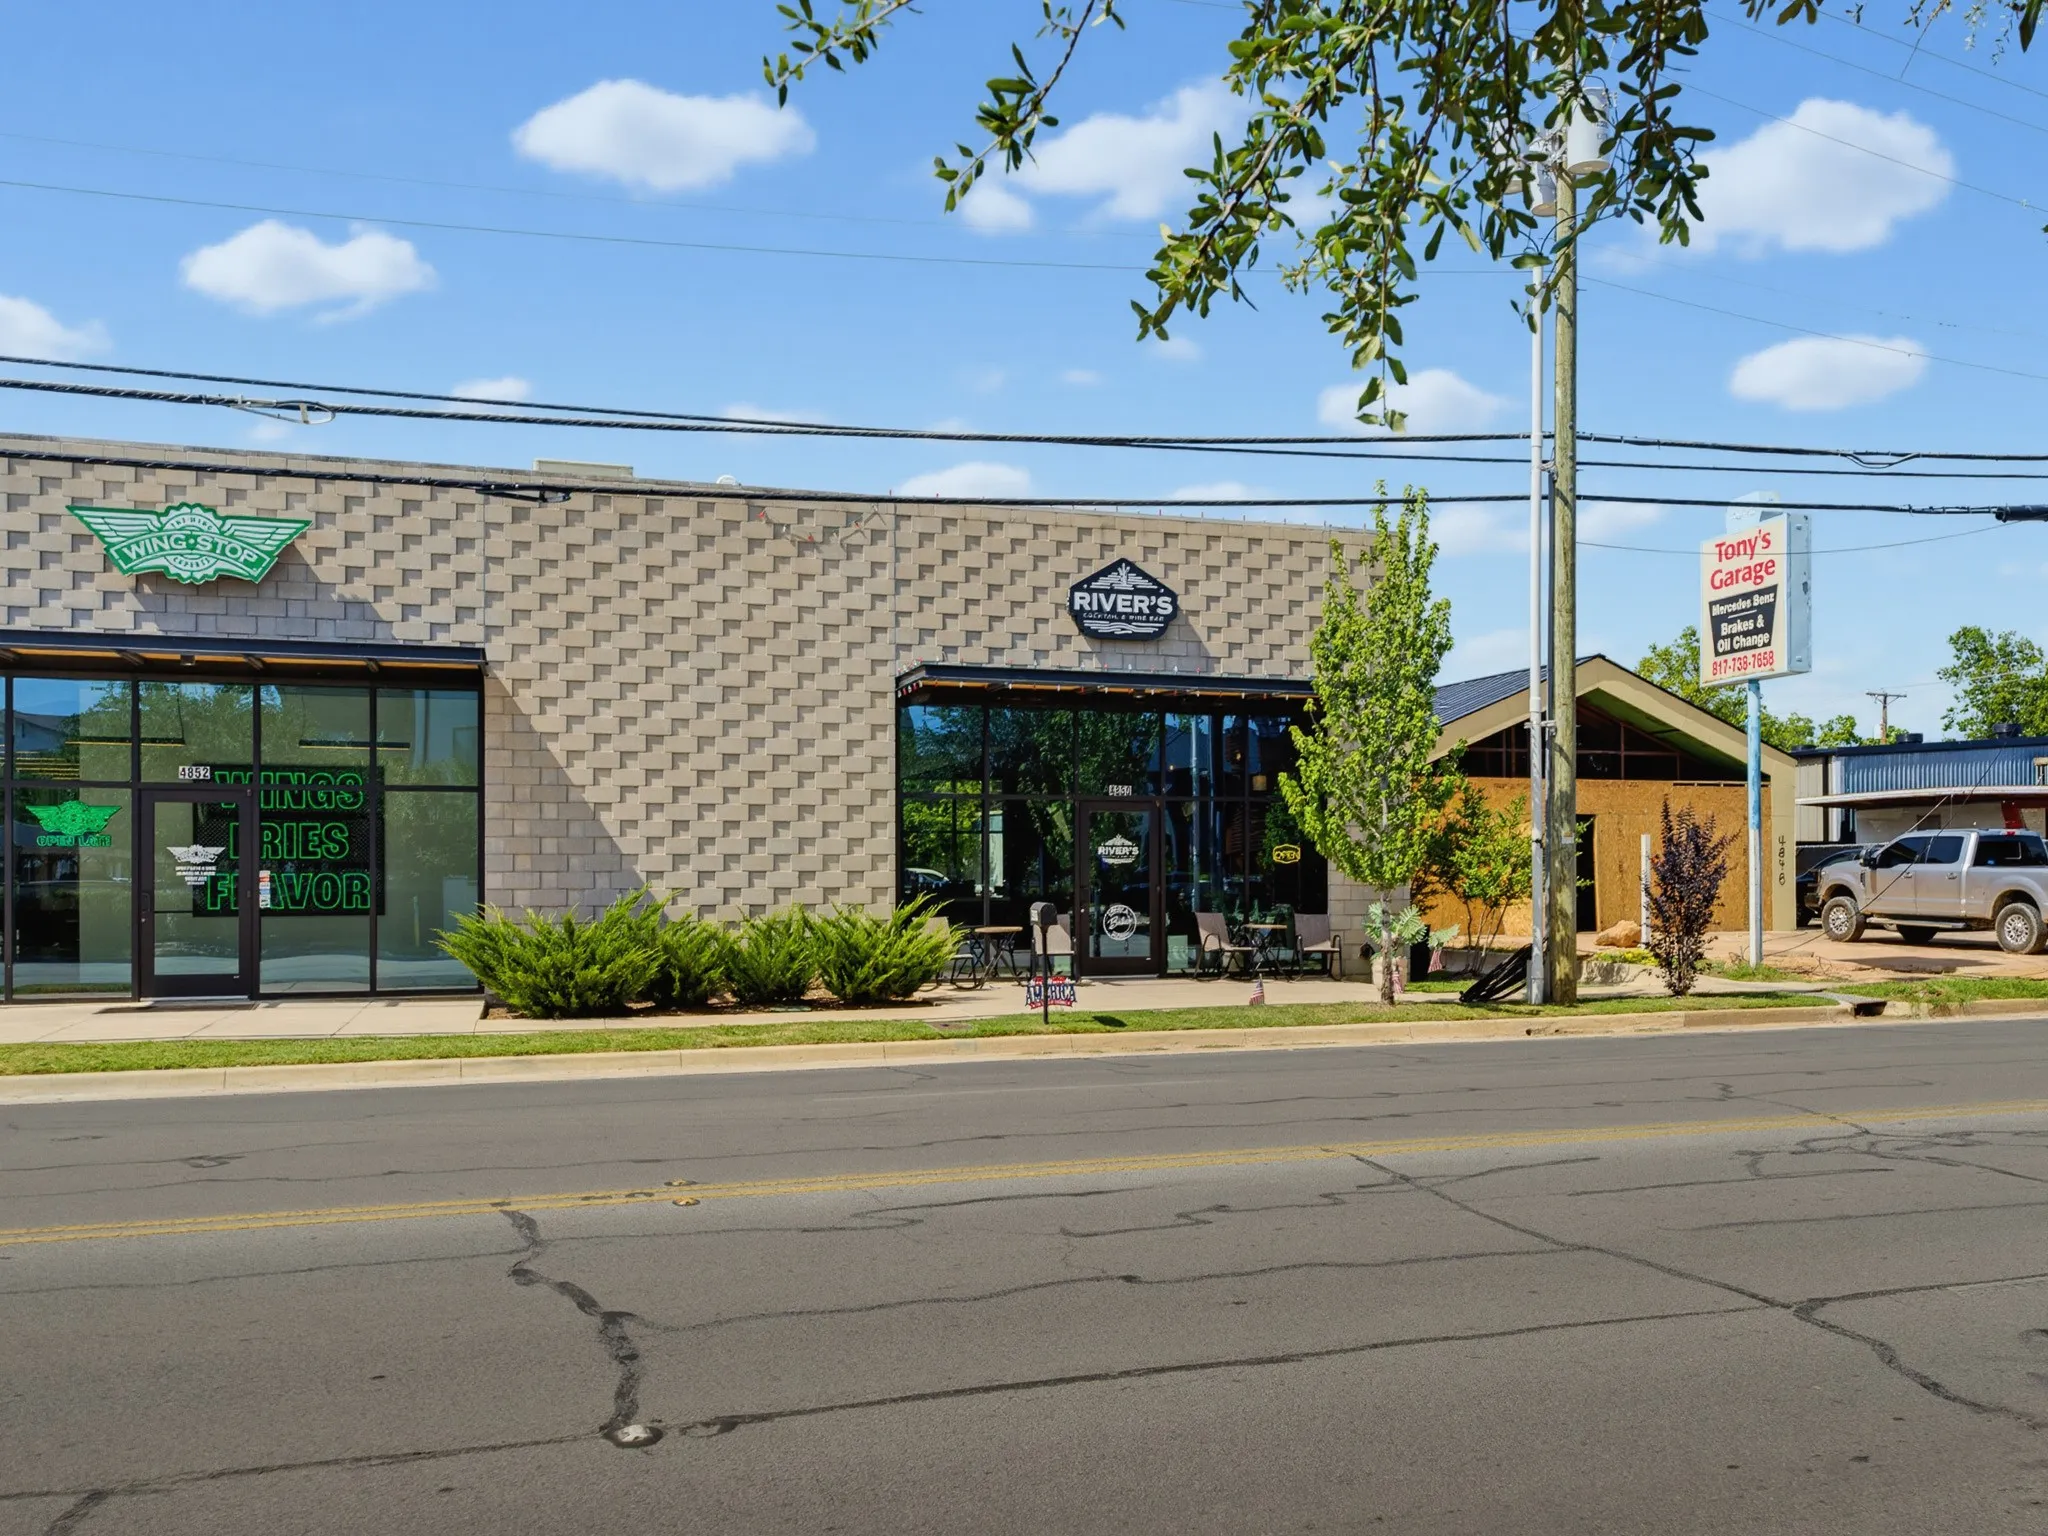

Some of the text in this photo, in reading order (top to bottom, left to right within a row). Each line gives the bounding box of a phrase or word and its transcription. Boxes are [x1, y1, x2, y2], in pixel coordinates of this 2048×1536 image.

[1714, 528, 1772, 563] Tony's
[1710, 558, 1776, 591] Garage
[1073, 591, 1173, 615] RIVER'S
[1711, 591, 1775, 617] Mercedes Benz
[1720, 613, 1765, 636] Brakes &
[1717, 631, 1770, 653] Oil Change
[179, 766, 210, 779] 4852
[1025, 983, 1077, 1006] AMRICA
